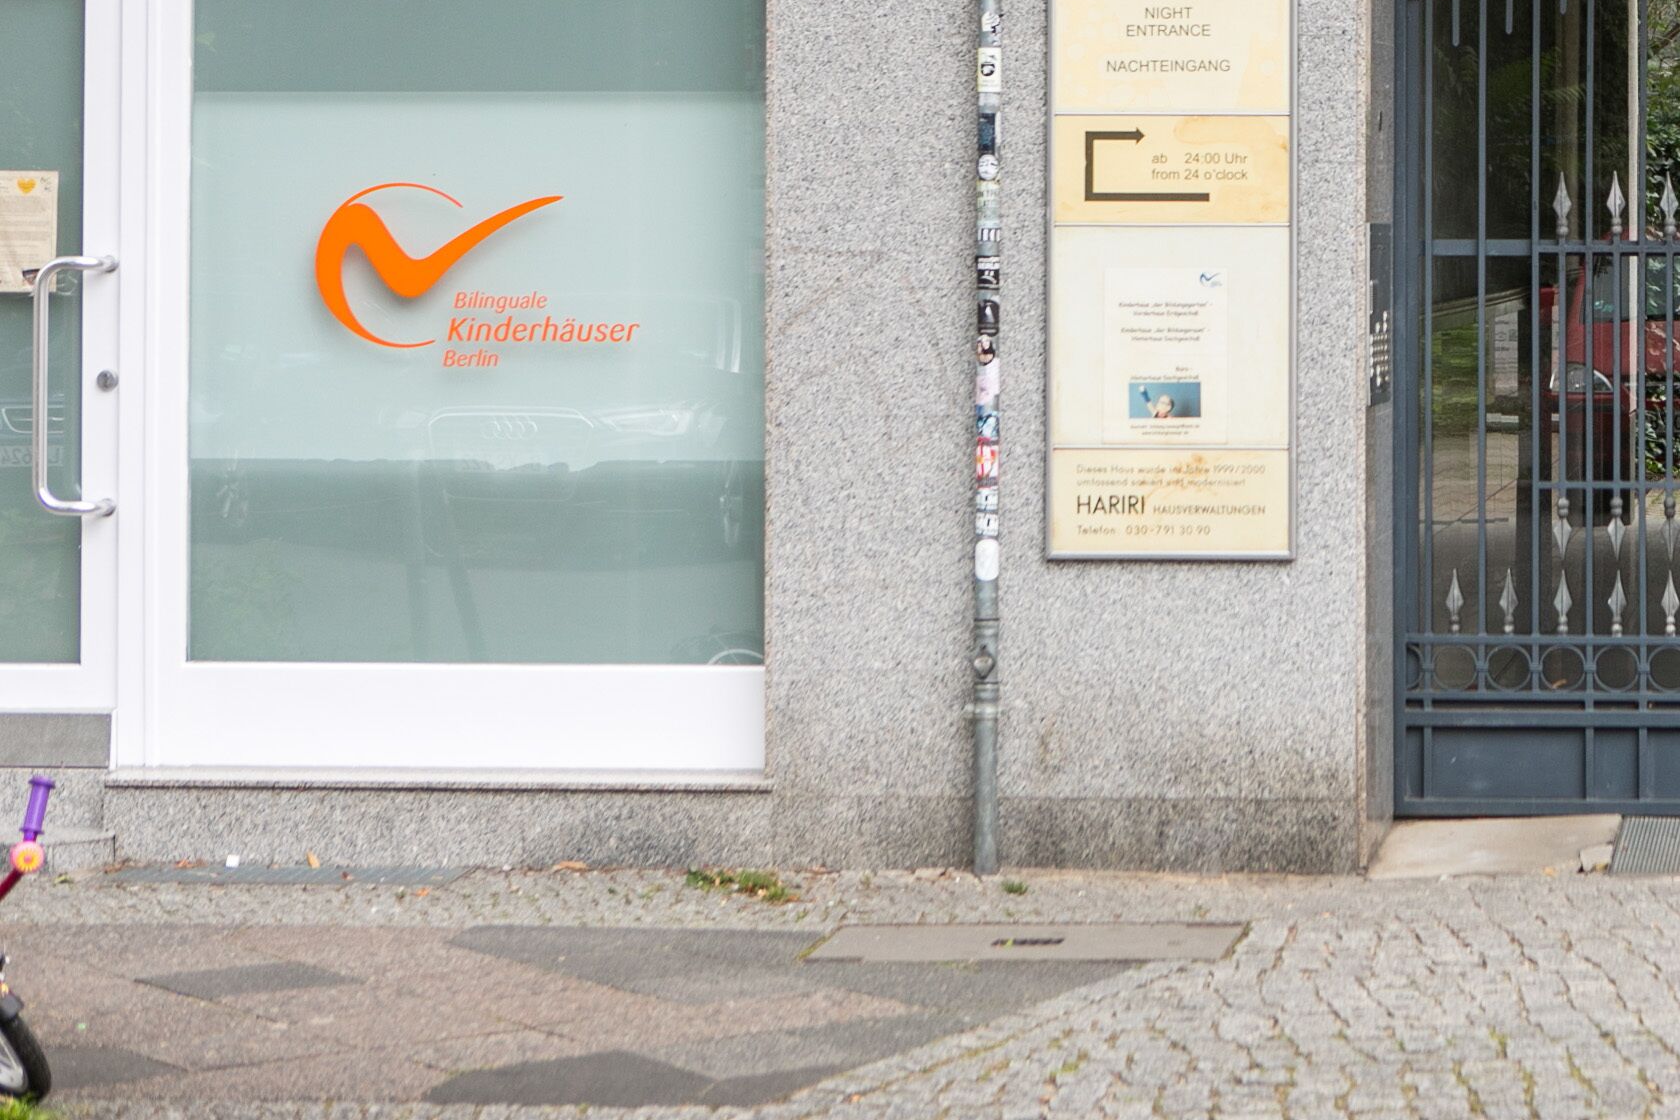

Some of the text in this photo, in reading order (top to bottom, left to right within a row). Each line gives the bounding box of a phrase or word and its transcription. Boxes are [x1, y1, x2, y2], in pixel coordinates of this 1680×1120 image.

[1145, 7, 1193, 19] NIGHT
[1126, 24, 1212, 37] ENTRANCE
[1106, 60, 1231, 73] NACHTEINGANG
[1152, 152, 1248, 164] ab 24:00 Uhr
[1152, 168, 1180, 180] from
[1184, 168, 1200, 180] 24
[454, 291, 548, 313] Bilinguale
[447, 316, 640, 342] Kinderhäuser
[443, 350, 499, 367] Berlin
[1077, 495, 1266, 515] HARIRI HAUSVERWALTUNGEN
